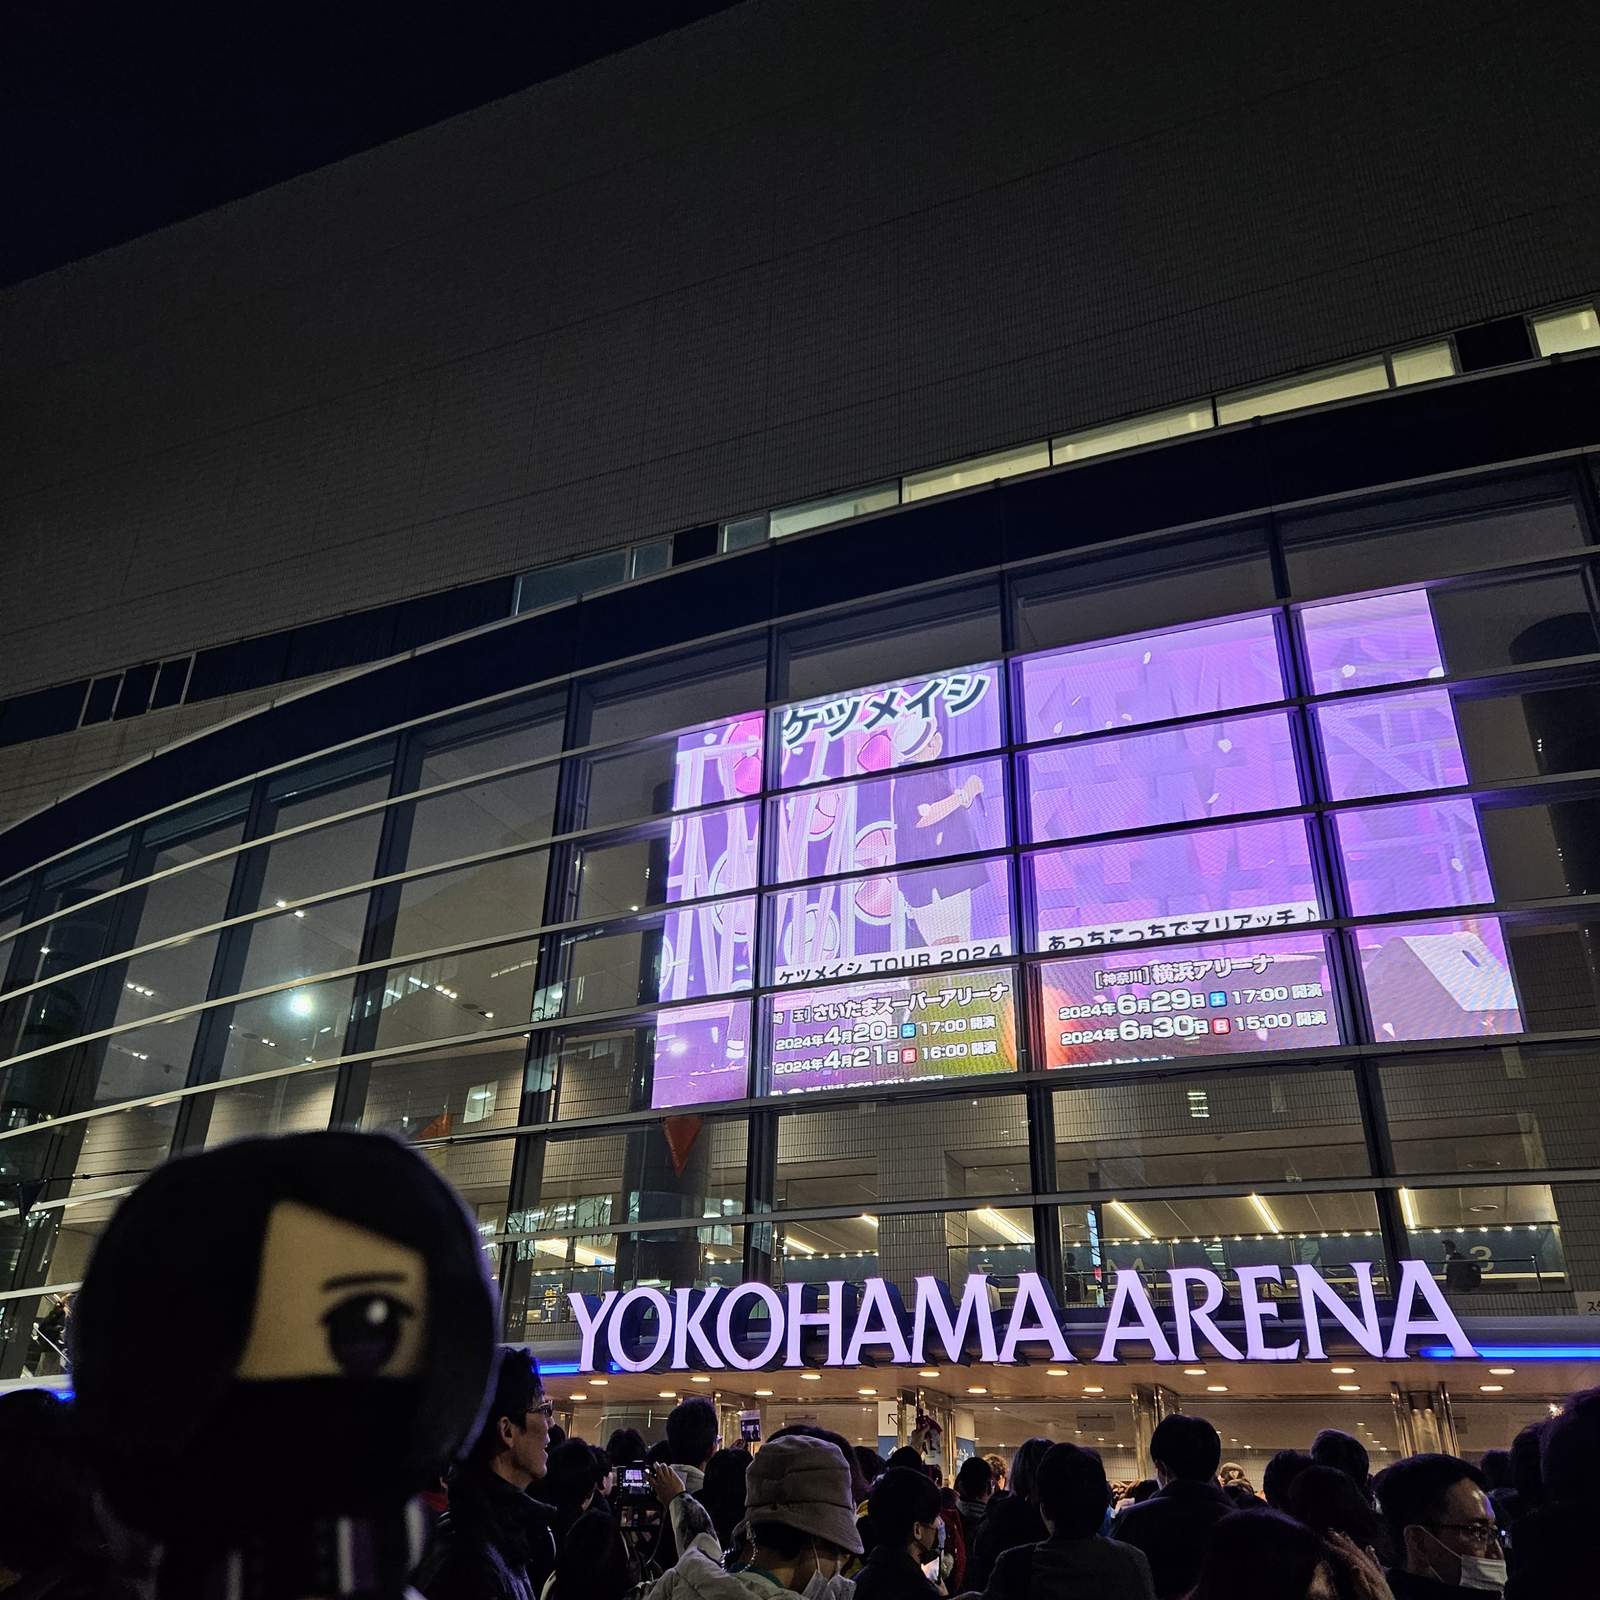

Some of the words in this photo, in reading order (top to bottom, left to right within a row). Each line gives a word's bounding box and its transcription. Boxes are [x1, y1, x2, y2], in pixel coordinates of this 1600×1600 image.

[783, 677, 989, 747] ケツメイシ
[1049, 909, 1295, 950] あっちこっちでマリアッチ
[778, 962, 862, 983] ケツメイシ
[871, 953, 930, 972] TOUR
[940, 944, 1002, 965] 2024
[1152, 953, 1274, 985] 横浜アリーナ
[813, 982, 1009, 1022] さいたまスーパーアリーナ
[1059, 988, 1206, 1020] 2024年6月29日
[1231, 986, 1288, 1005] 17:00
[775, 1021, 898, 1051] 2024年4月20日
[921, 1018, 967, 1036] 17:00
[1061, 1014, 1209, 1046] 2024年6月30日
[1235, 1012, 1292, 1031] 15:00
[774, 1044, 899, 1075] 2024年4月21日
[921, 1043, 968, 1060] 16:00
[1470, 1245, 1494, 1272] 3
[568, 1272, 1078, 1373] YOKOHAMA
[1091, 1259, 1483, 1362] ARENA
